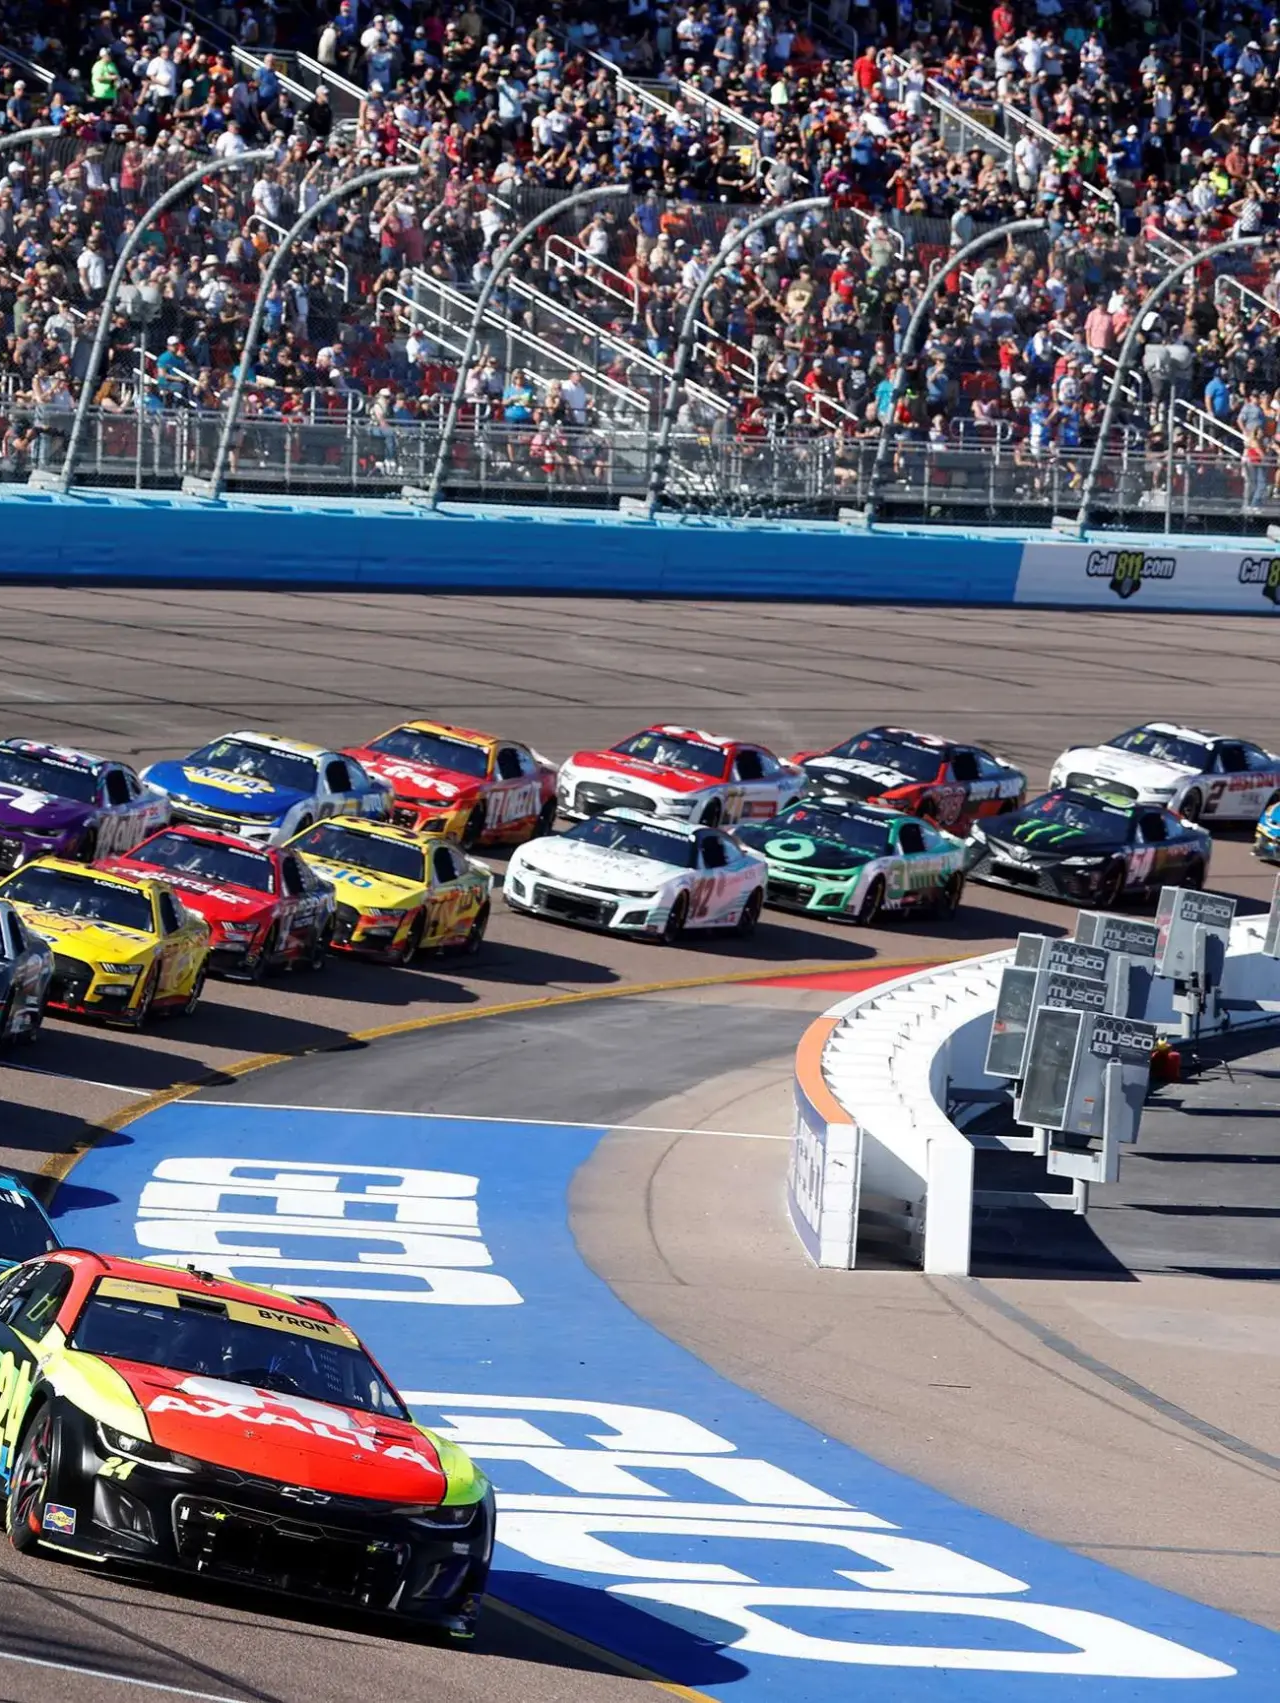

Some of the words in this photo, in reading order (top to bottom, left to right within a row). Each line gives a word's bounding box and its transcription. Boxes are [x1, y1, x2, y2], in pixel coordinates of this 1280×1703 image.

[196, 766, 261, 789] NAPA
[93, 878, 140, 895] LOGANO
[134, 1157, 525, 1307] GEICO
[257, 1308, 330, 1335] BYRON
[147, 1394, 442, 1474] AXALTA
[97, 1456, 138, 1481] 24
[404, 1391, 1239, 1679] GEICO
